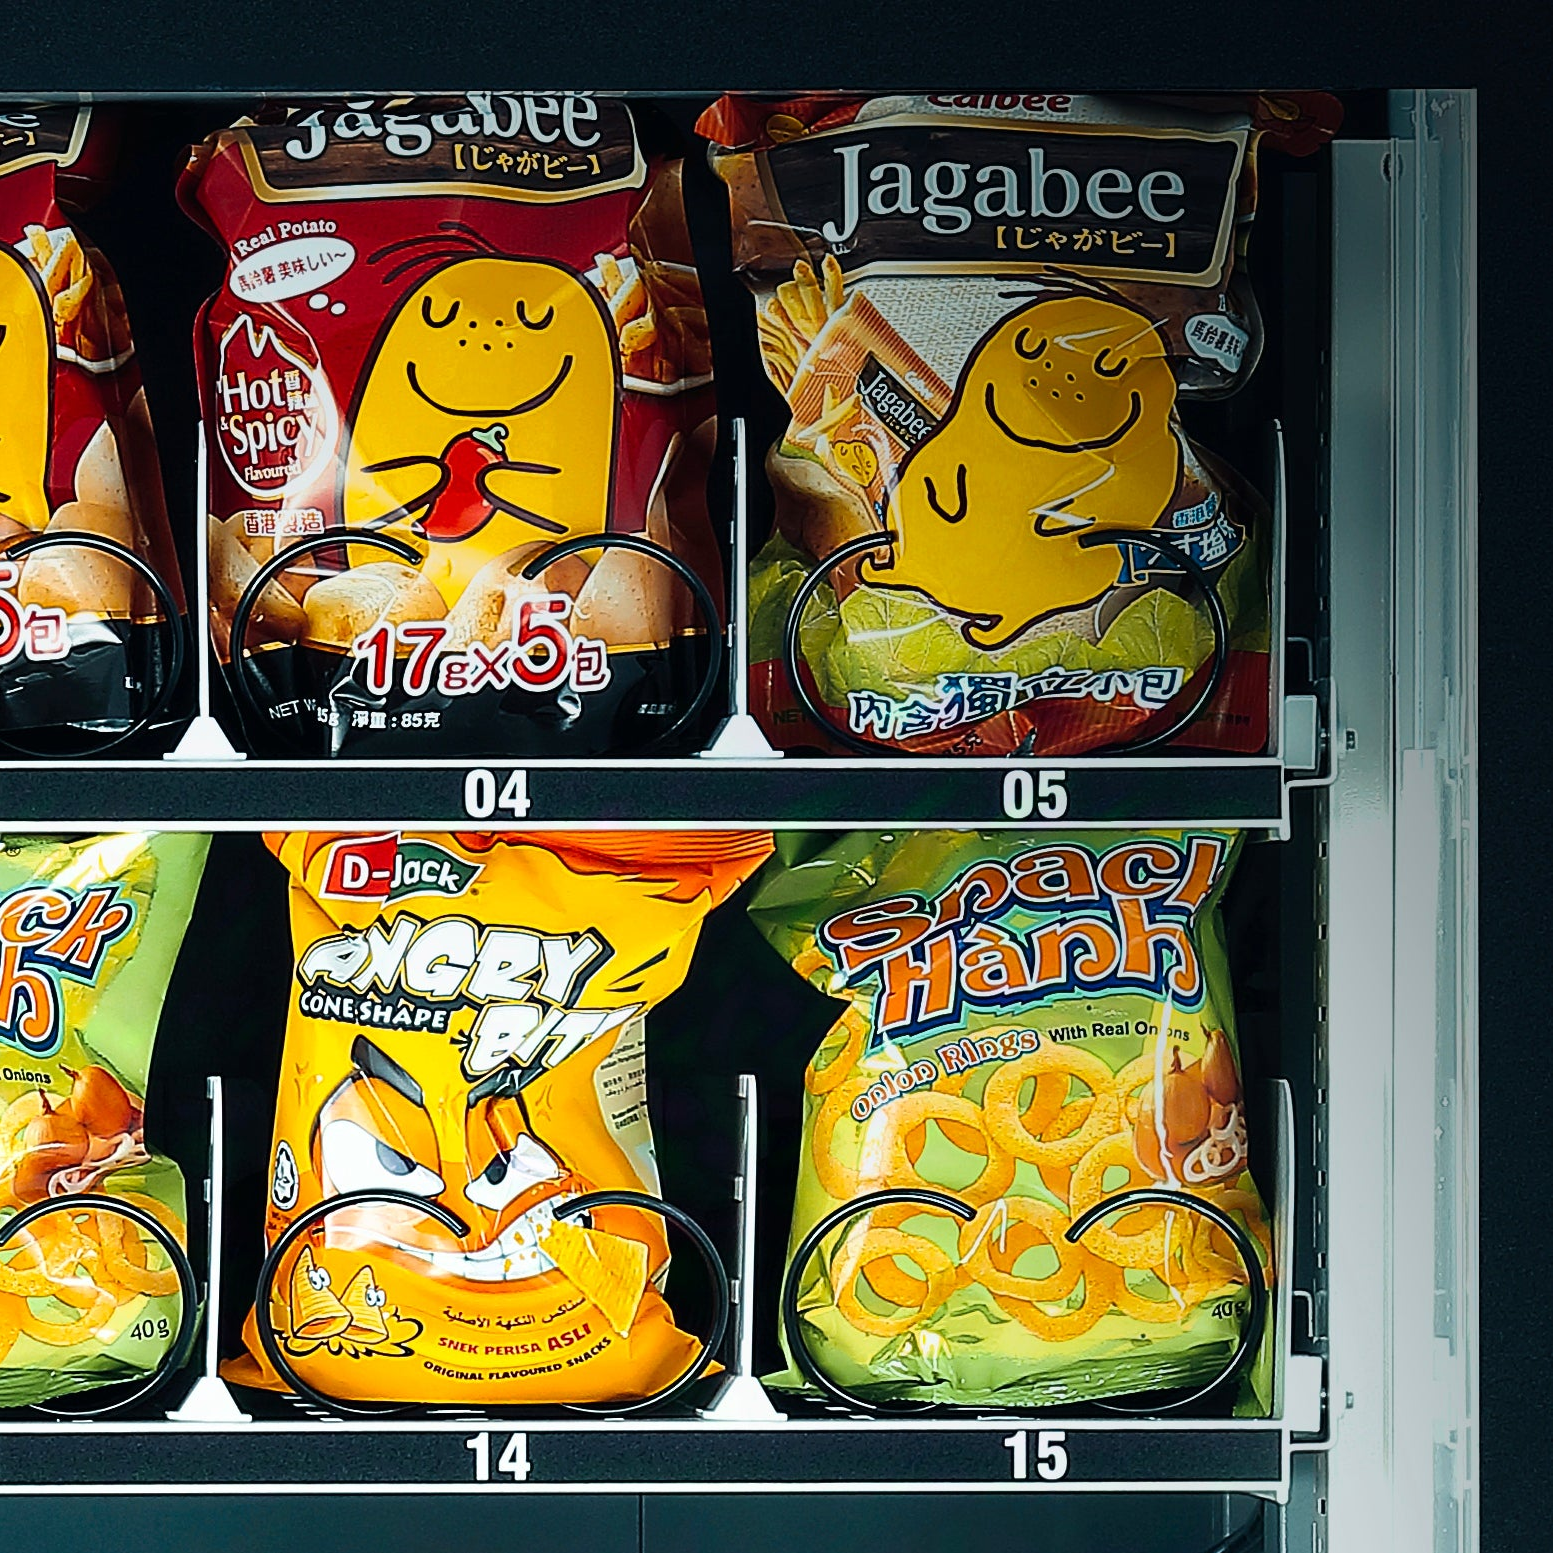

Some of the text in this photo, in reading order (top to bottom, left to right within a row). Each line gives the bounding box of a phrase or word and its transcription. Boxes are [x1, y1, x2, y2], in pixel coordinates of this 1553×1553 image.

[823, 142, 1187, 243] Jagabee
[234, 220, 337, 257] Real Potato
[220, 369, 284, 413] Hot
[229, 413, 318, 465] Spicy
[244, 457, 302, 481] Flavoured
[269, 702, 300, 719] NET
[465, 769, 530, 817] 04
[1004, 771, 1067, 818] 05
[341, 852, 462, 892] D-Jack
[299, 912, 607, 1003] ANGRY
[3, 1067, 52, 1085] Onions
[850, 1021, 1130, 1124] Onion Rings With Real
[131, 1318, 169, 1340] 40g
[437, 1323, 592, 1356] SNEK PERISA ASLI
[423, 1336, 612, 1381] ORIGINAL FLAVOURED SNACKS
[467, 1434, 530, 1480] 14
[1005, 1434, 1067, 1479] 15
